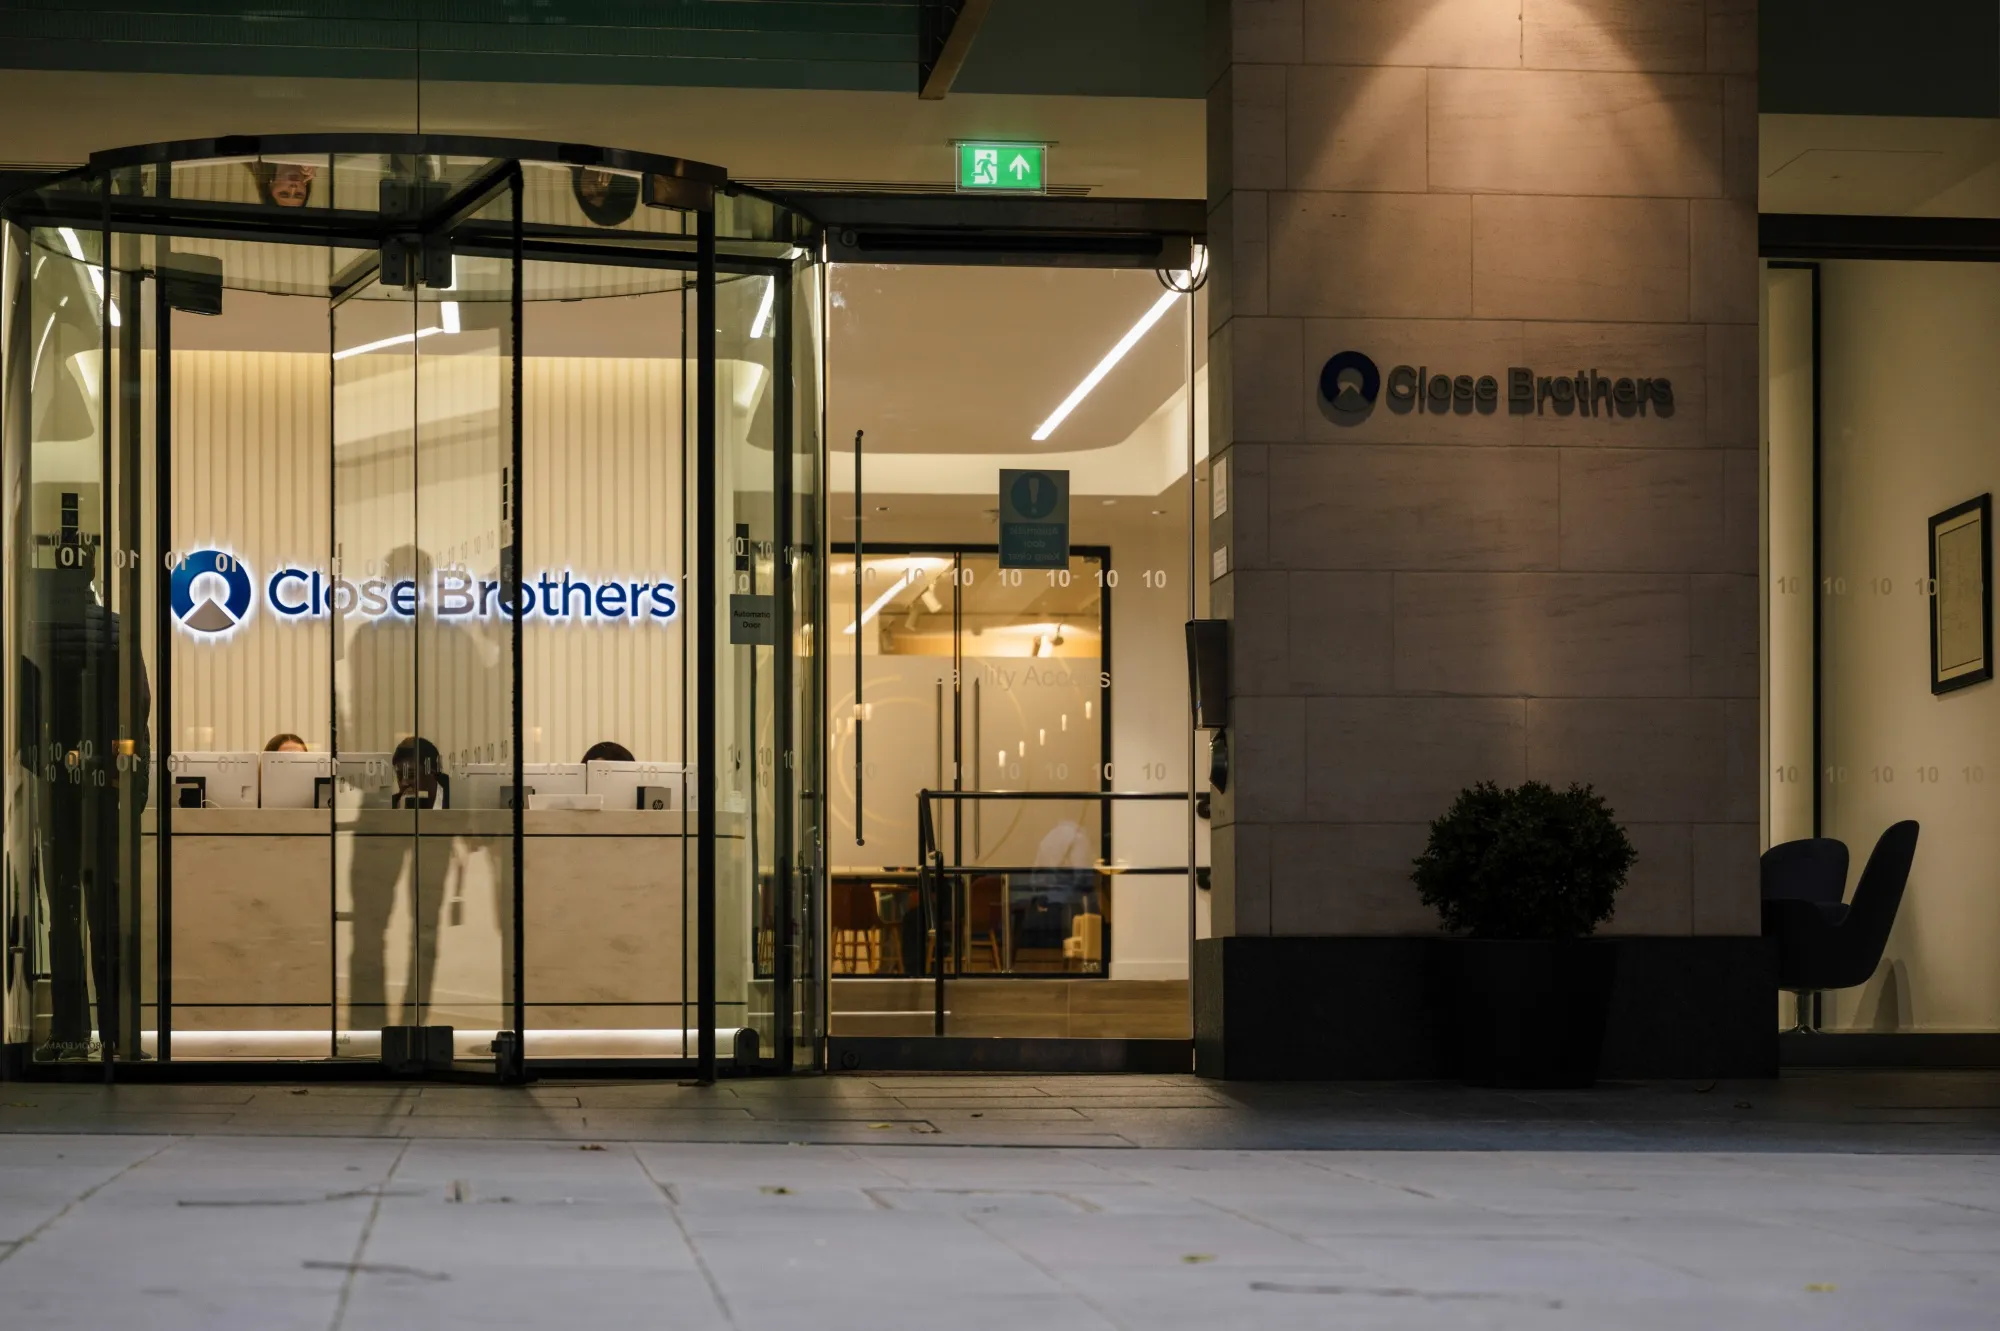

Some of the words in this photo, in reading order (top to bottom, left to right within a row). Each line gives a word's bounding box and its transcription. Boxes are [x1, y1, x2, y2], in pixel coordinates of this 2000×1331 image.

[1387, 365, 1498, 401] Close
[1508, 367, 1673, 402] Brothers
[759, 540, 772, 560] 10
[951, 568, 975, 587] 10
[998, 568, 1022, 587] 10
[1046, 569, 1071, 588] 10
[1094, 569, 1119, 588] 10
[1142, 569, 1167, 588] 10
[1776, 576, 1799, 595] 10
[1824, 577, 1847, 595] 10
[1871, 577, 1893, 596] 10
[1915, 577, 1938, 596] 10
[269, 569, 419, 616] Close
[437, 571, 676, 617] Brothers
[733, 610, 771, 618] Automatic
[742, 621, 761, 629] Door
[49, 742, 62, 762] 10
[77, 740, 93, 759] 10
[758, 747, 772, 766] 10
[45, 763, 57, 782] 10
[68, 767, 80, 784] 10
[92, 769, 105, 787] 10
[1044, 763, 1068, 781] 10
[1091, 762, 1116, 781] 10
[1142, 763, 1167, 781] 10
[1776, 765, 1799, 783] 10
[1826, 766, 1848, 783] 10
[1872, 766, 1895, 783] 10
[1916, 766, 1940, 783] 10
[1961, 766, 1985, 783] 10
